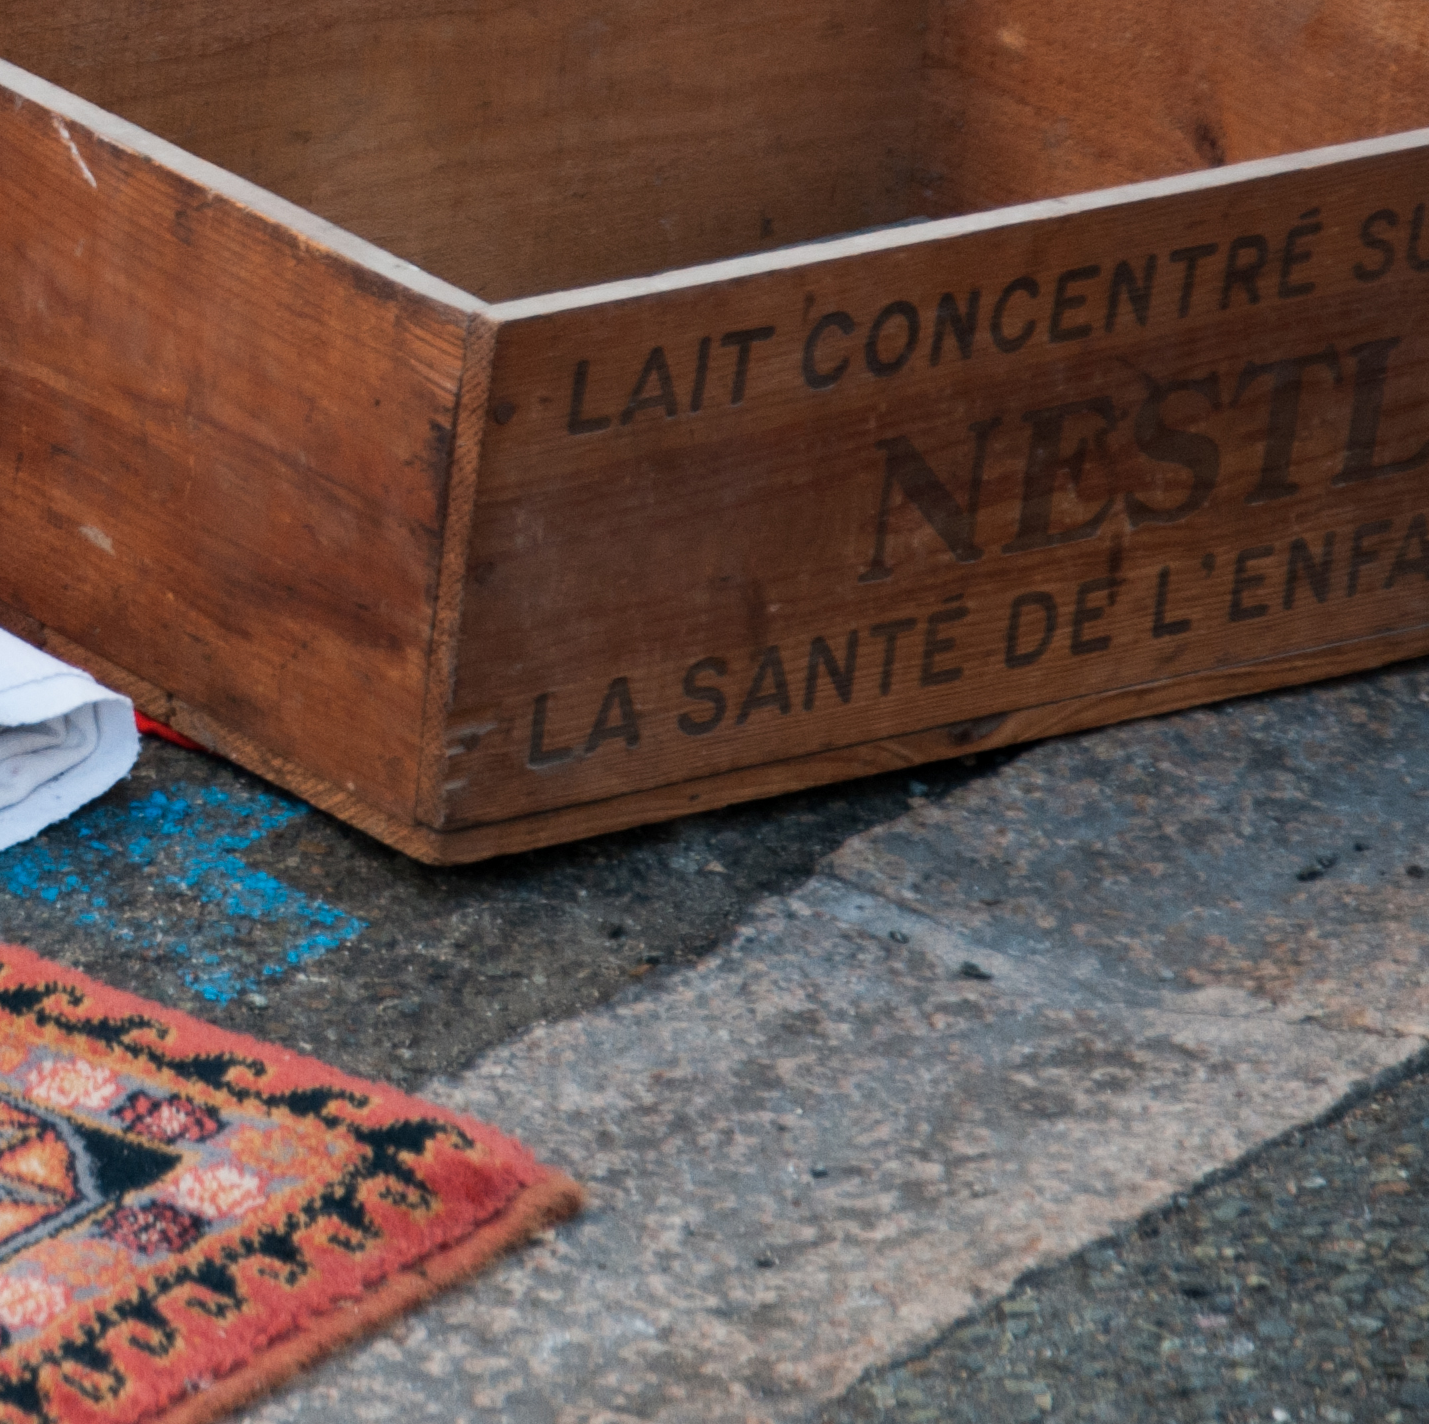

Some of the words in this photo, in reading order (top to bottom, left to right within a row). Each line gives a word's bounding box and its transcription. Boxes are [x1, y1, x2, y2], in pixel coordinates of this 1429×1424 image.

[565, 325, 776, 435] LAIT
[801, 208, 1324, 389] CONCENTRÉ
[857, 336, 1429, 585] NESTL
[526, 675, 642, 770] LA
[676, 594, 970, 737] SANTÉ
[1003, 583, 1116, 669] DE
[1149, 511, 1429, 639] L'ENFA
